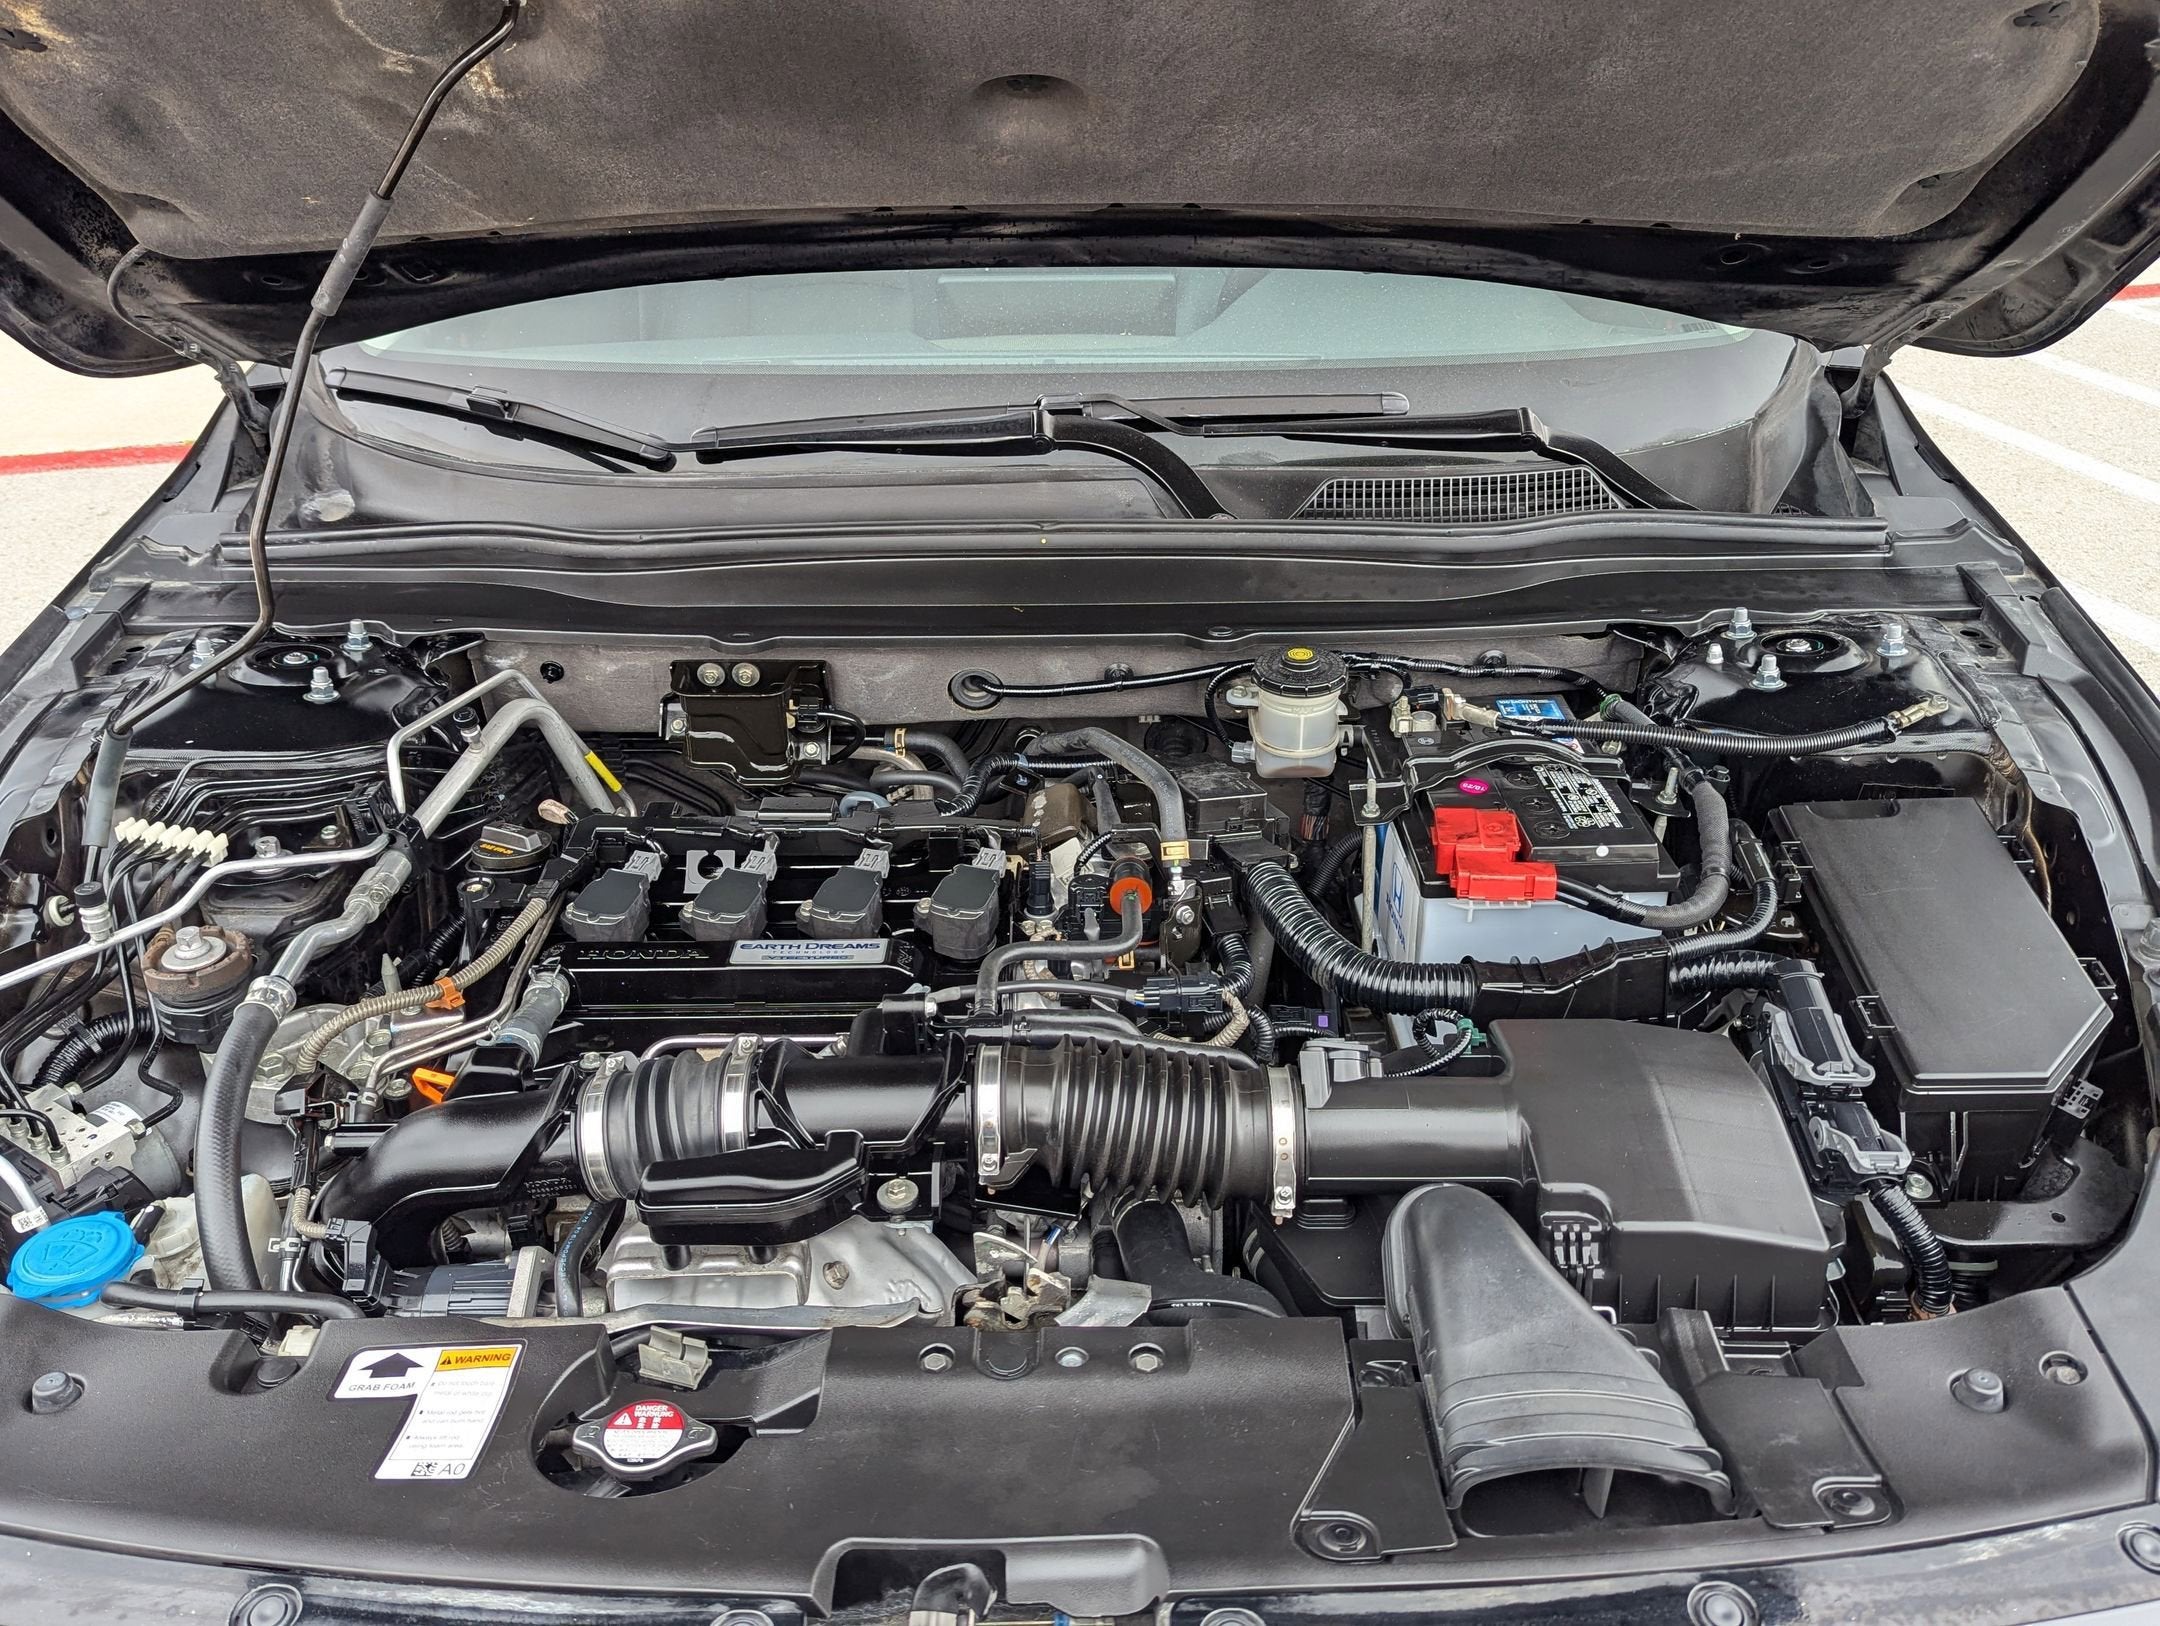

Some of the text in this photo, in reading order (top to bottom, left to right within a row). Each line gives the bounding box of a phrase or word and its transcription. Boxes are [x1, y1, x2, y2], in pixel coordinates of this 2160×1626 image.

[805, 942, 880, 950] DREAMS
[577, 949, 710, 960] HONDA
[454, 1352, 512, 1365] WARNING
[348, 1381, 416, 1392] GRAB FOAM
[437, 1463, 466, 1476] A0
